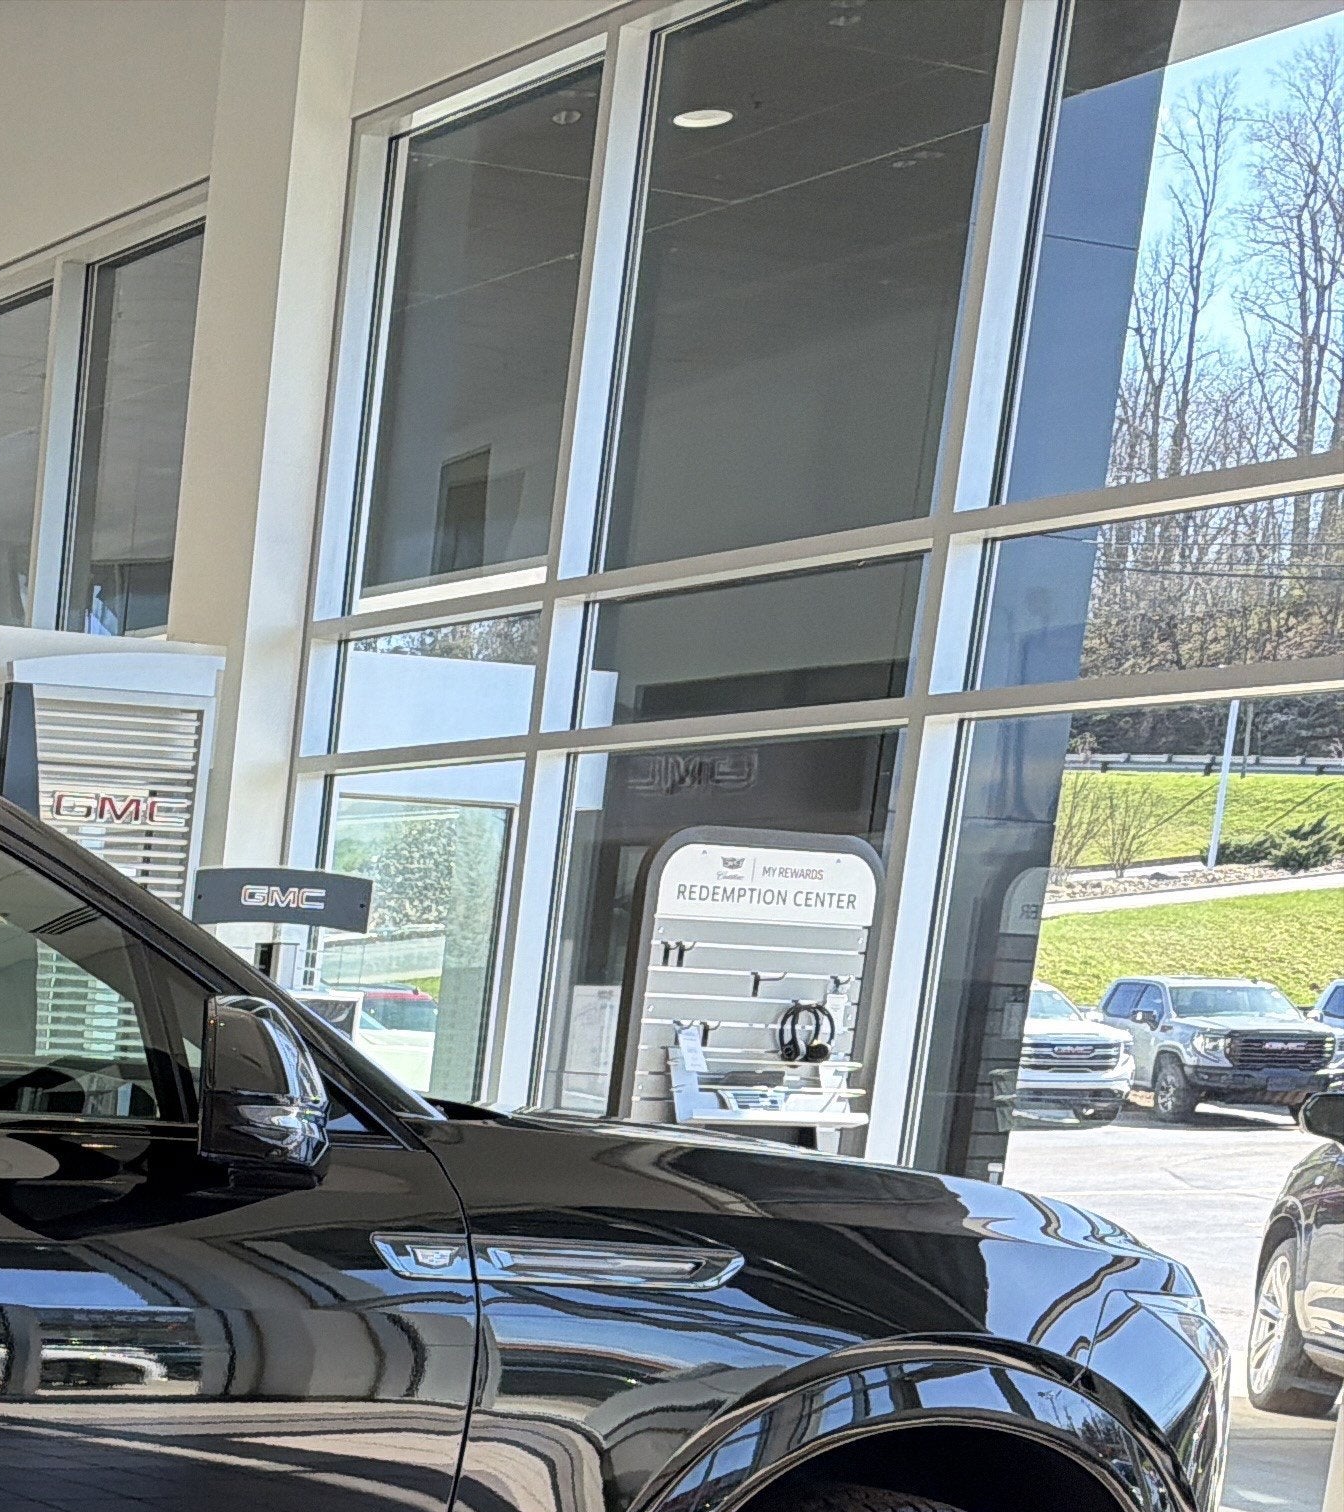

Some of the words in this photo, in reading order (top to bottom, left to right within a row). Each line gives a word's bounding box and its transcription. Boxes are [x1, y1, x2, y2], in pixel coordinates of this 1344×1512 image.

[53, 790, 192, 827] GMC
[762, 866, 777, 878] MY
[778, 866, 824, 881] REWARDS
[240, 884, 326, 910] GMC
[676, 883, 788, 906] REDEMPTION
[793, 890, 857, 910] CENTER
